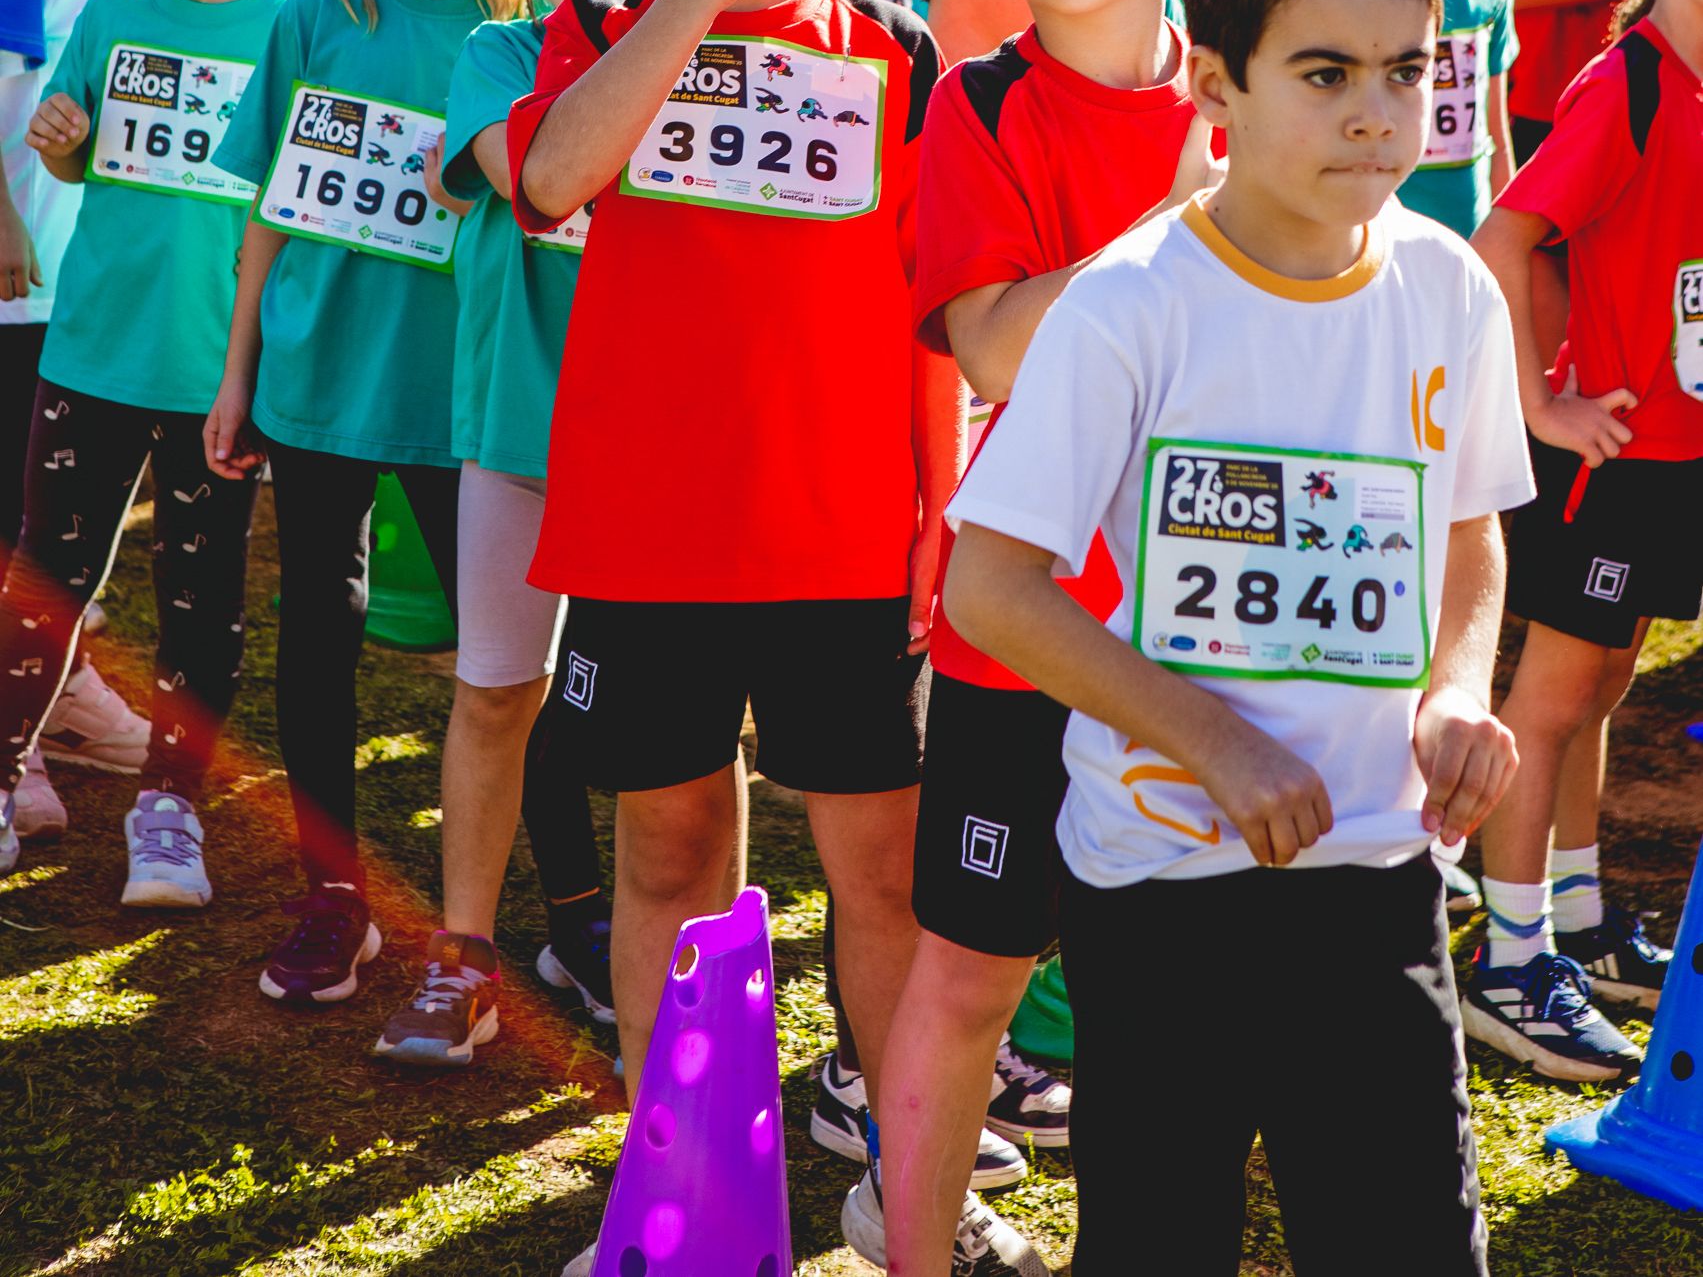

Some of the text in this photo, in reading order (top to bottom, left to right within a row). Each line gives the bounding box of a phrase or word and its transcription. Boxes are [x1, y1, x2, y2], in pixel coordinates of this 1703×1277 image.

[114, 71, 176, 100] CROS
[673, 66, 741, 95] ROS
[681, 92, 692, 101] de
[693, 93, 713, 103] Sant
[714, 95, 740, 106] Cugat
[298, 116, 360, 148] CROS
[659, 120, 839, 183] 3926
[295, 164, 428, 227] 1690
[1168, 490, 1278, 531] CROS
[1168, 523, 1276, 544] Ciutat de Sant Cugat
[1174, 564, 1387, 633] 2840
